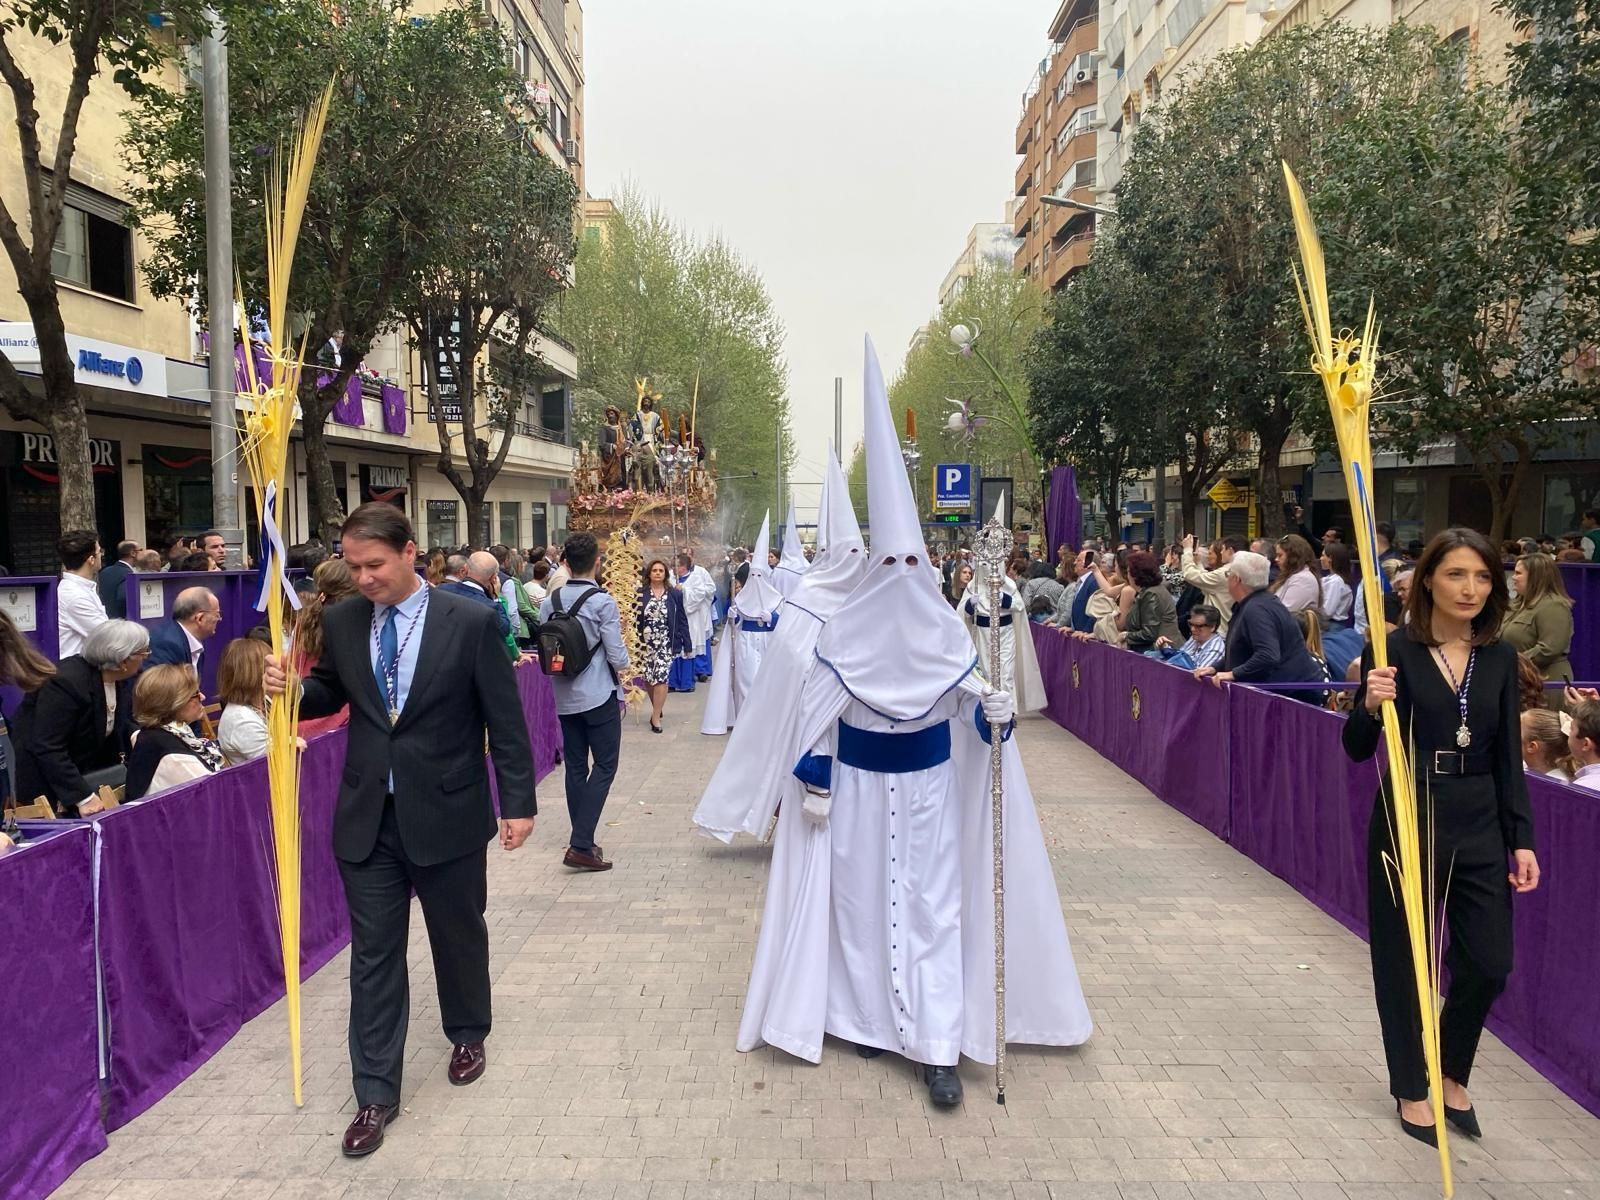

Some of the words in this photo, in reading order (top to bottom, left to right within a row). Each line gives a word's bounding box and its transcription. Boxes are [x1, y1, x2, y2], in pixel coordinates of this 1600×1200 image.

[78, 349, 126, 378] Allianz
[22, 433, 115, 467] PROR
[945, 468, 962, 491] P
